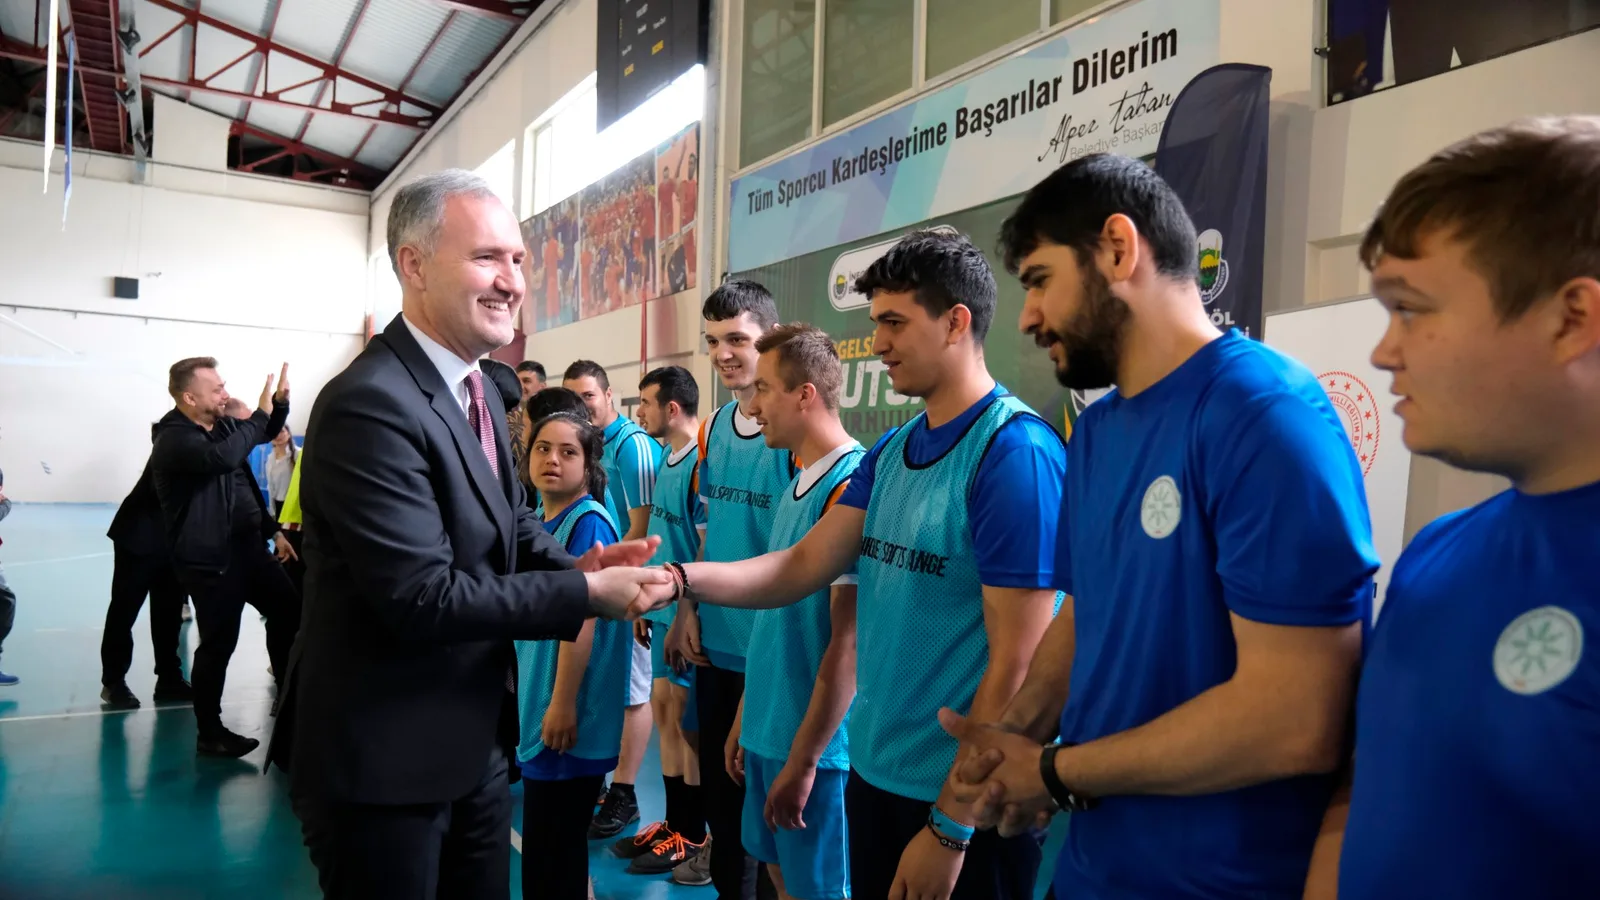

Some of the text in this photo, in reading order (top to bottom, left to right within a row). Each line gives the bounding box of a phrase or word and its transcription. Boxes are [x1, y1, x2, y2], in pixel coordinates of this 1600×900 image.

[748, 27, 1177, 215] Tüm Sporcu Kardeşlerime Başarılar Dilerim
[1208, 308, 1235, 327] ÖL
[834, 330, 878, 360] GELSİ
[839, 359, 920, 409] UTS
